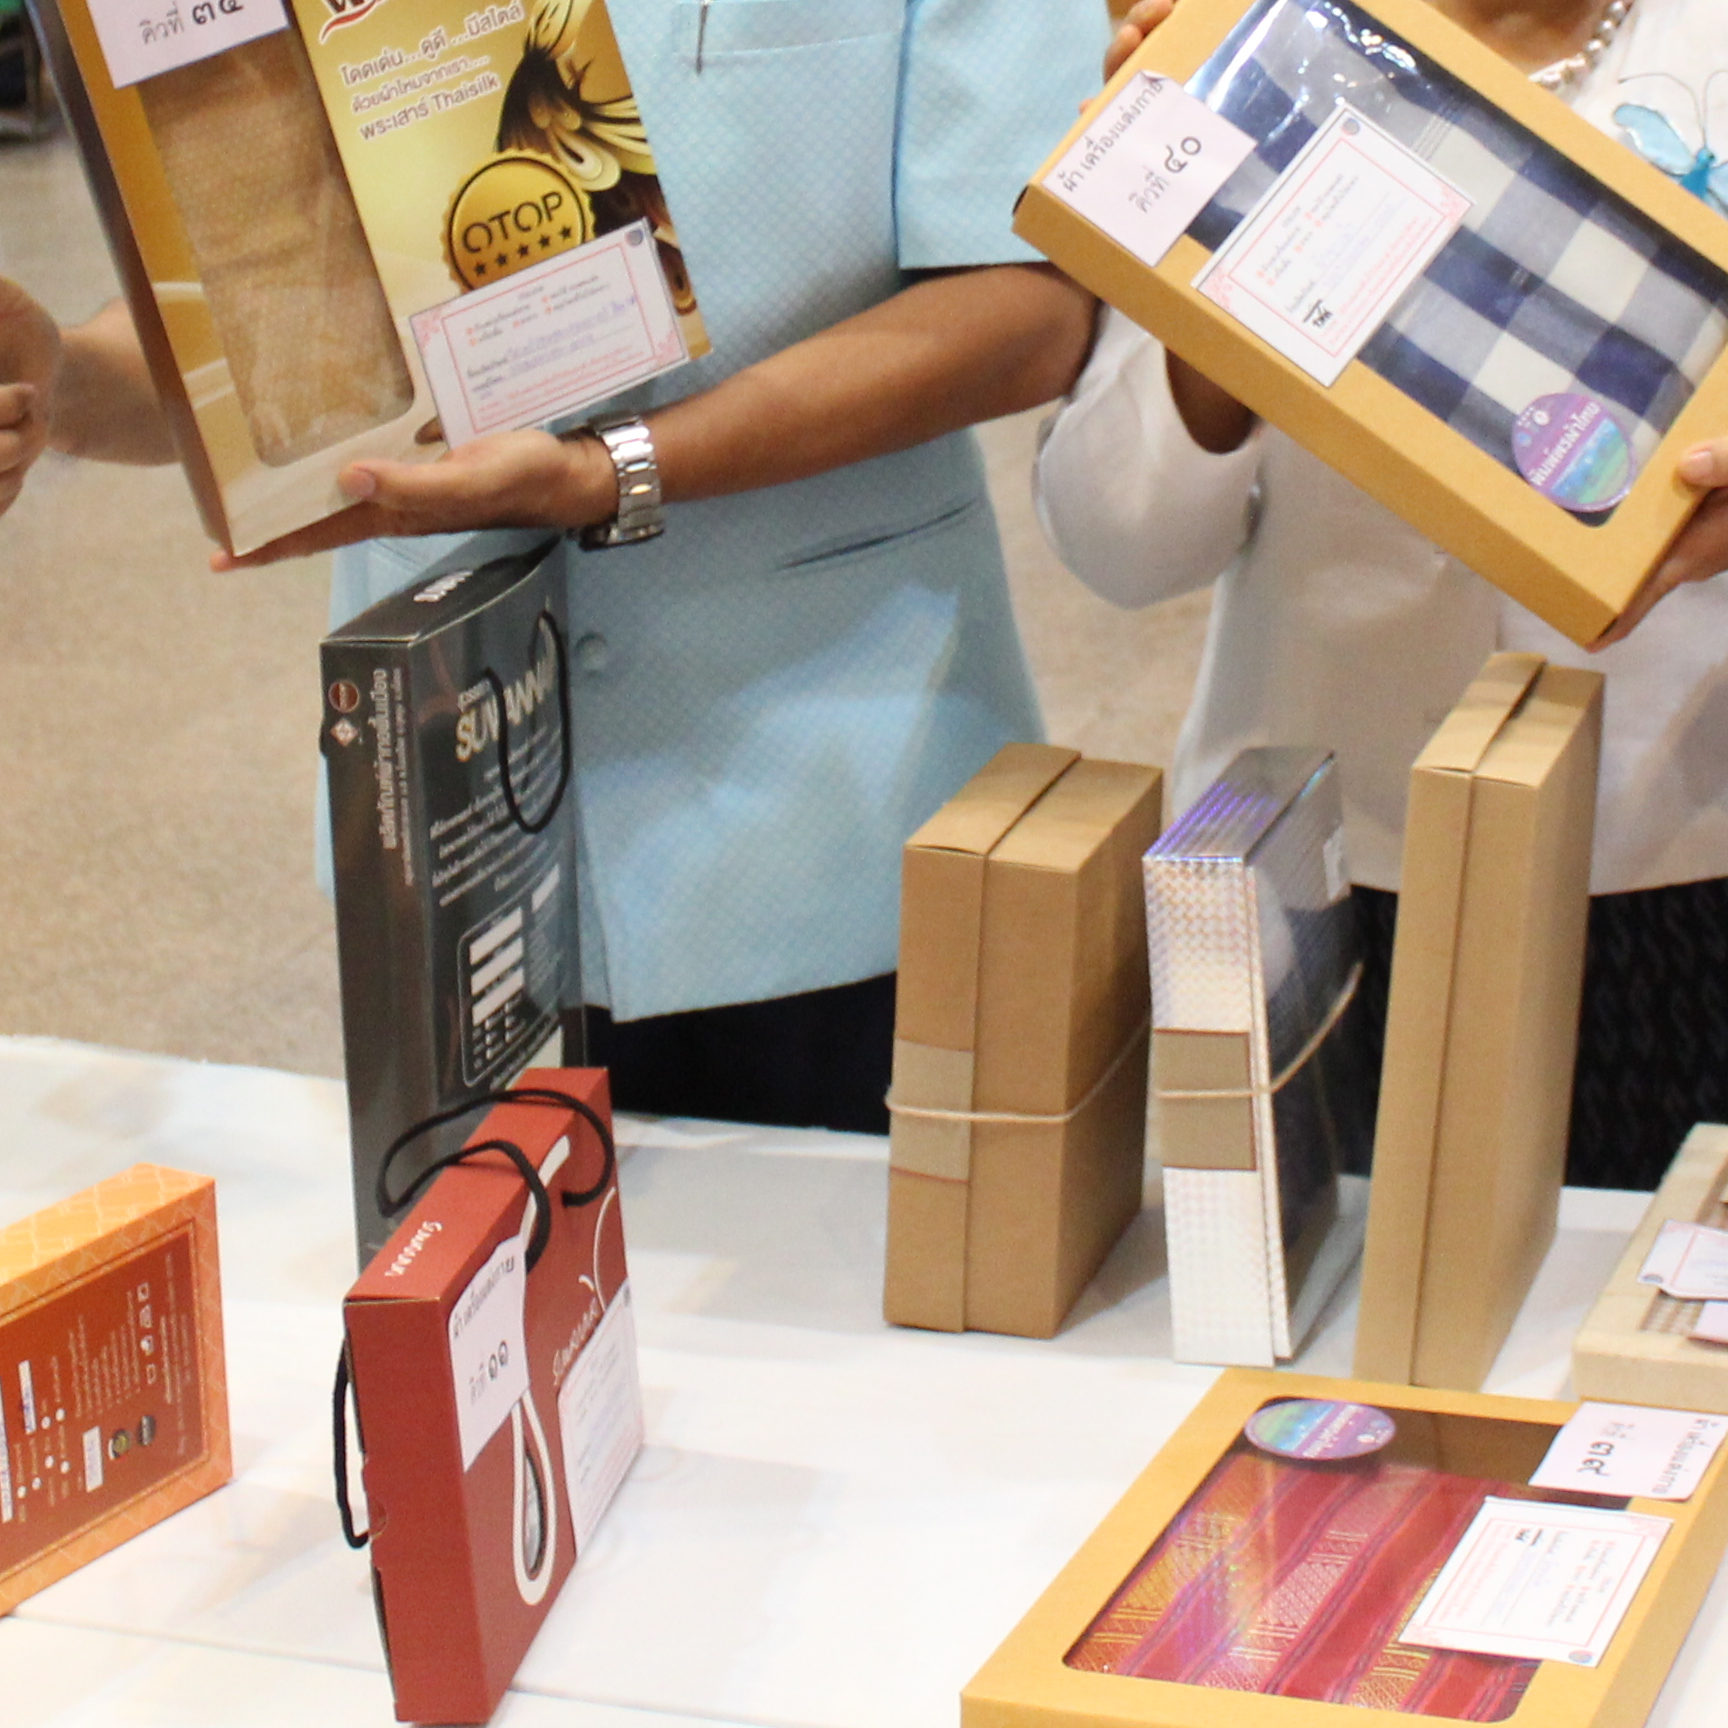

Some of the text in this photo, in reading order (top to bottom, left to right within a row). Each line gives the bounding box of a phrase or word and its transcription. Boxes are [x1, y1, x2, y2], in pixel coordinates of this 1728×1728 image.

[138, 1, 185, 45] คิวที่
[359, 70, 501, 140] พระเสาร์ Thaisilk
[1058, 171, 1085, 193] ผ้า
[1128, 135, 1203, 214] คิวที่ ๔๐
[462, 191, 563, 254] OTOP
